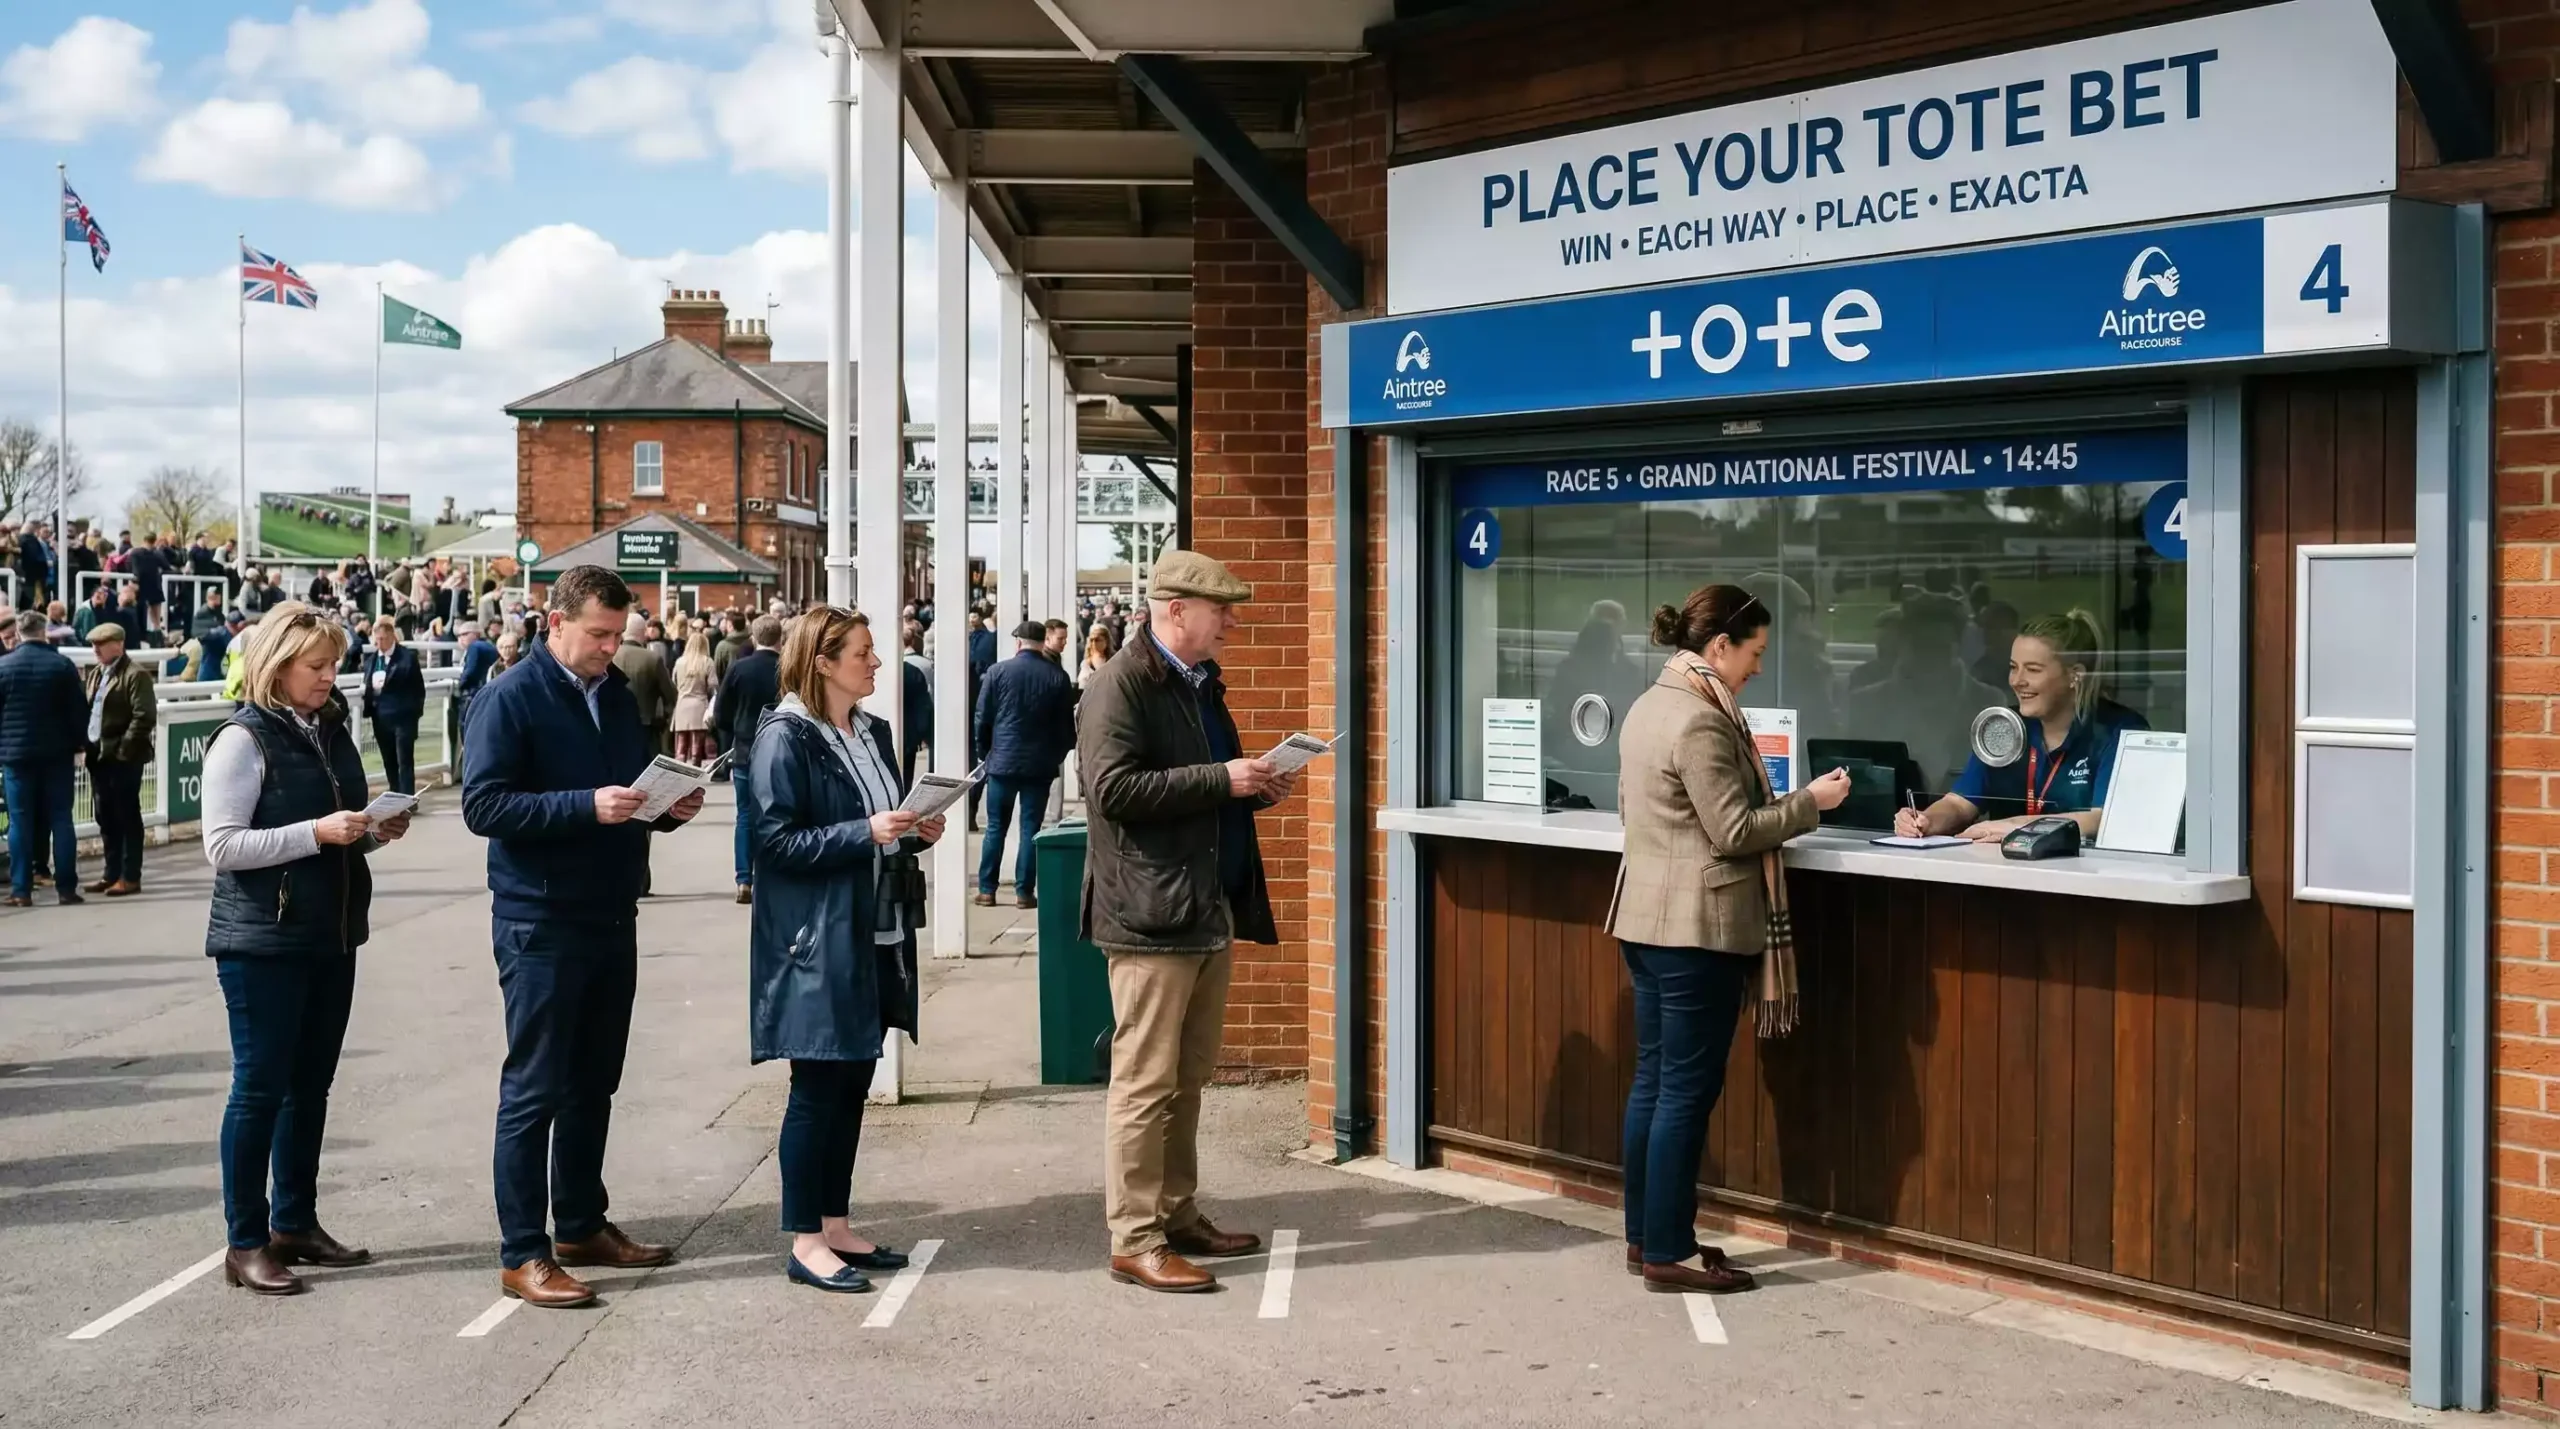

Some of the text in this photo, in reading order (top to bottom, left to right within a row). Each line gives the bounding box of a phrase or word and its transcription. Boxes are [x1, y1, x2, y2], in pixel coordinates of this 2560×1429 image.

[1483, 48, 2219, 229] PLACE YOUR TOTE BET
[1560, 164, 2089, 266] WIN EACH WAY PLACE EXACTA
[2299, 243, 2350, 314] 4
[1631, 288, 1883, 379] tote
[2098, 308, 2206, 338] Aintree
[2120, 337, 2183, 350] RACECOURSE
[1382, 377, 1447, 400] Aintree
[1546, 442, 2078, 493] RACE 5 GRAND NATIONAL FESTIVAL 14:45
[1469, 521, 1489, 556] 4
[2163, 498, 2188, 541] 4
[180, 735, 209, 764] AIN
